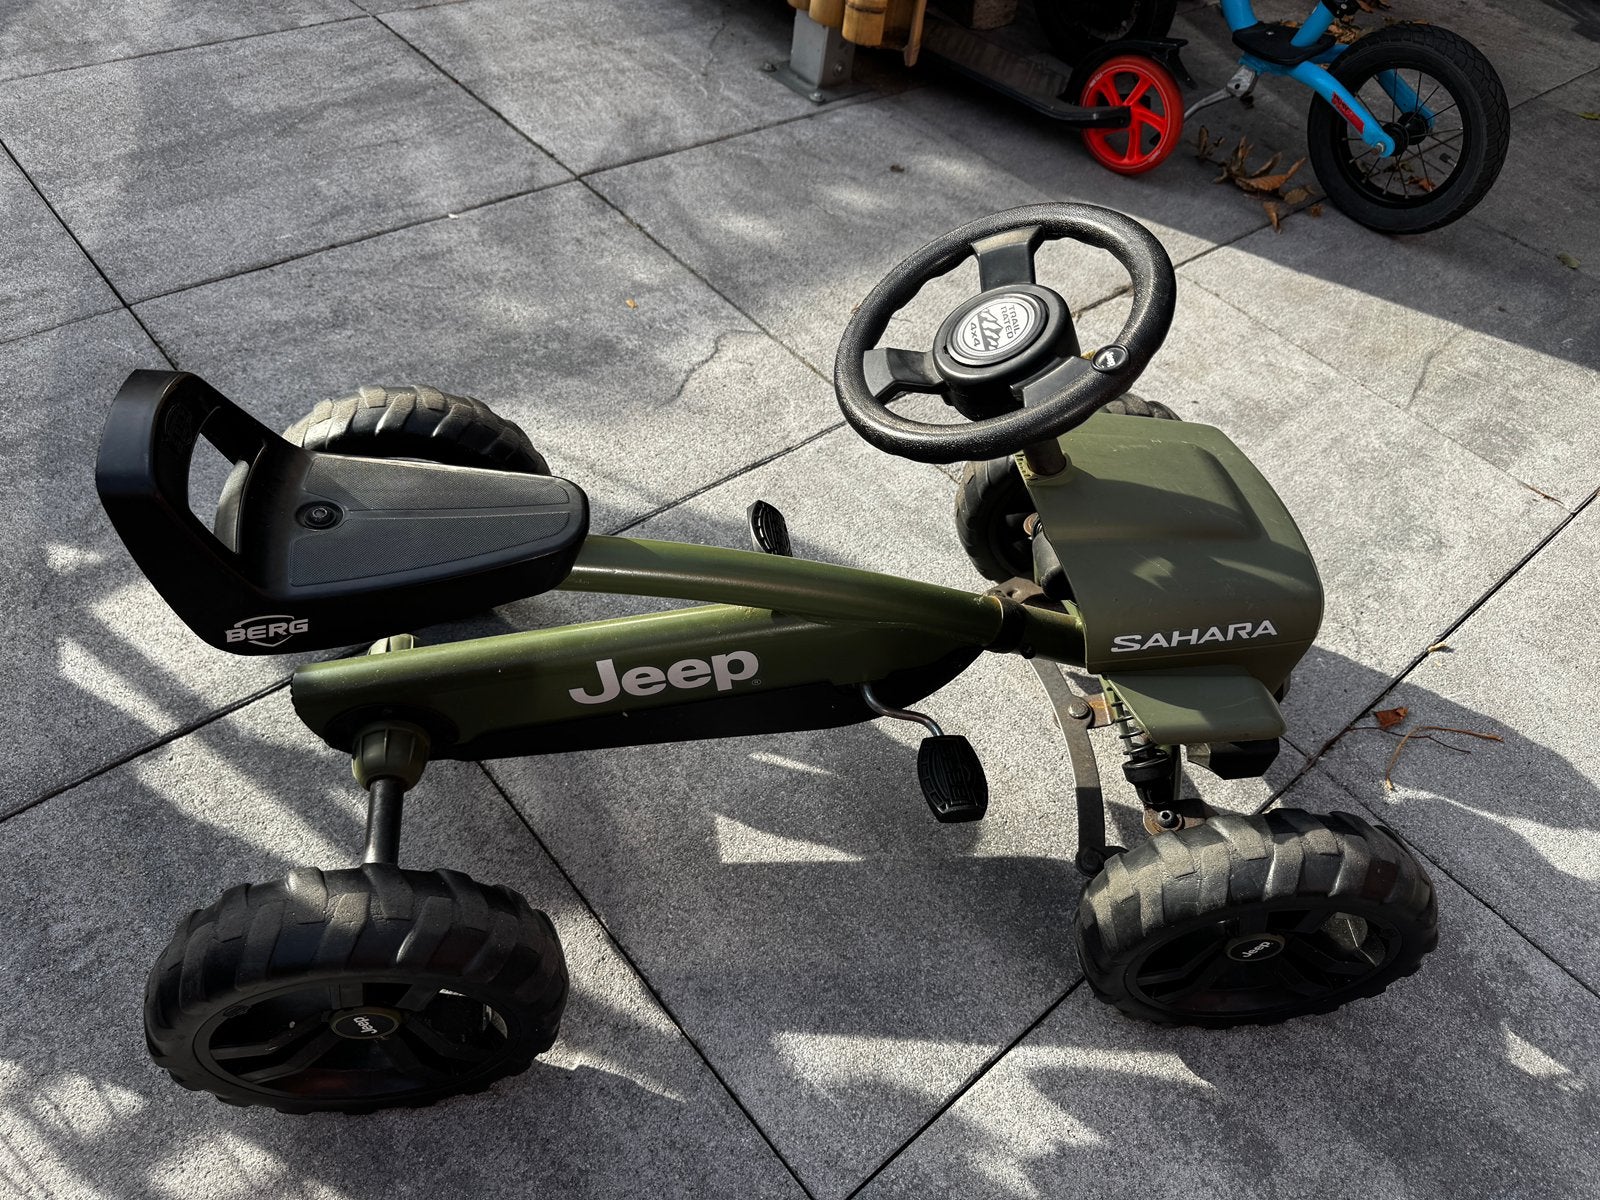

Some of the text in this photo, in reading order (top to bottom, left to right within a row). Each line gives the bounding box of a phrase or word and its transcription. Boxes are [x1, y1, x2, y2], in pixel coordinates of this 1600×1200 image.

[1001, 306, 1013, 339] RATED
[1009, 305, 1020, 334] TRAIL
[225, 618, 308, 643] BERG
[1111, 620, 1277, 653] SAHARA
[568, 650, 759, 705] Jeep
[1242, 941, 1271, 958] Jeep
[353, 1016, 378, 1034] Jeep
